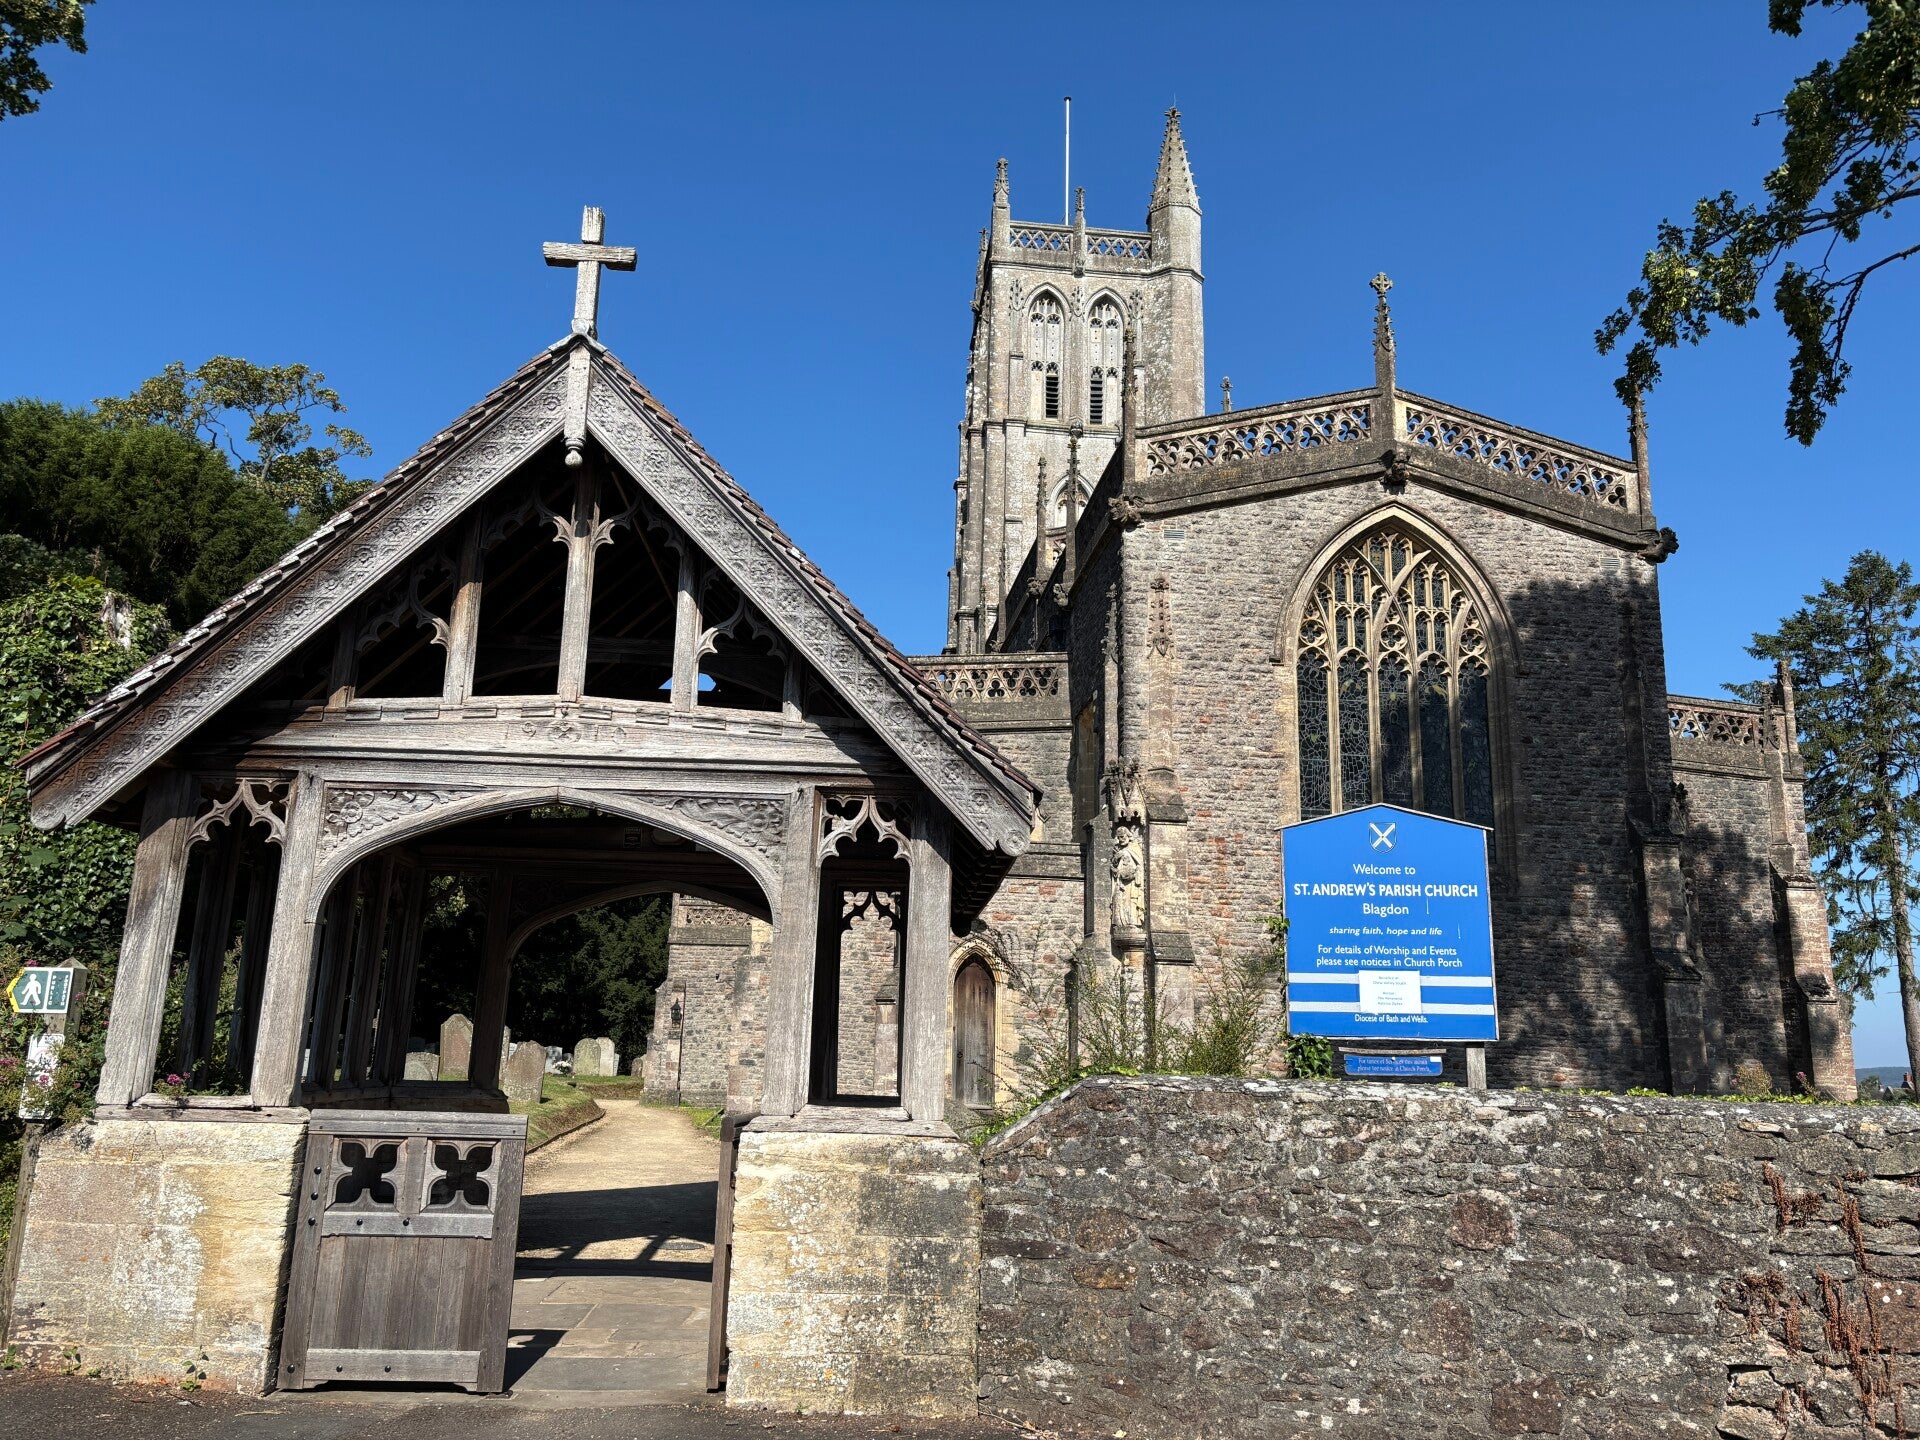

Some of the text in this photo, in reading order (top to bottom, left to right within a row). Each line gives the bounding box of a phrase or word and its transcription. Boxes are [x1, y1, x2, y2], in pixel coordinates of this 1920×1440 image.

[1352, 863, 1416, 875] Welcome to
[1312, 882, 1376, 896] ANDREW'S
[1379, 884, 1421, 896] PARISH
[1424, 884, 1478, 897] CHURCH
[1362, 902, 1409, 918] Blagdon
[1329, 926, 1443, 937] sharing faith, hope and life
[1317, 944, 1457, 957] For details of Worship and Events
[1316, 956, 1463, 968] please see notices in Church Porch
[48, 974, 57, 1006] PUBLIC
[60, 974, 69, 1006] FOOTPATH
[1354, 1013, 1428, 1023] Diocese of Bath and Wells.
